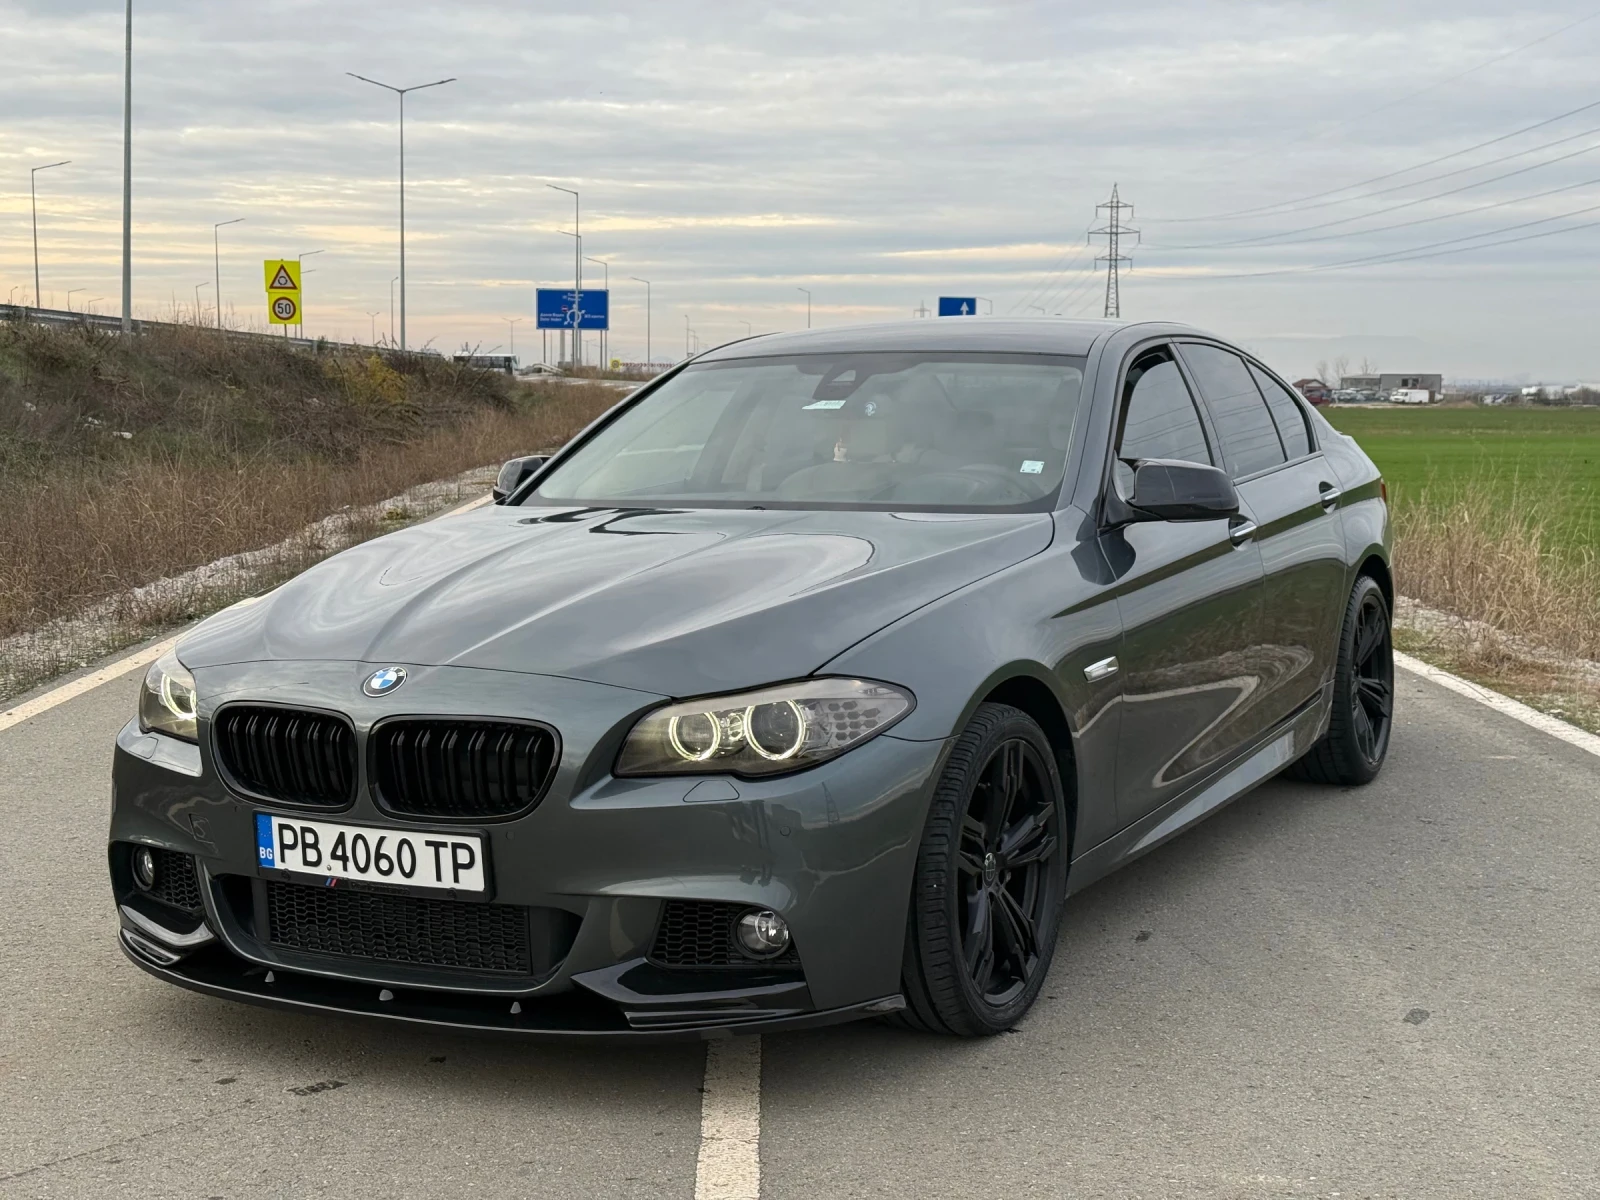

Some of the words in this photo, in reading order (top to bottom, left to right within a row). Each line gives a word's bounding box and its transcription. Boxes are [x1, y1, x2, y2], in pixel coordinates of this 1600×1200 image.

[277, 303, 292, 315] 50
[259, 847, 273, 860] BG
[278, 823, 323, 867] PB
[331, 832, 417, 878] 4060
[425, 840, 475, 883] TP
